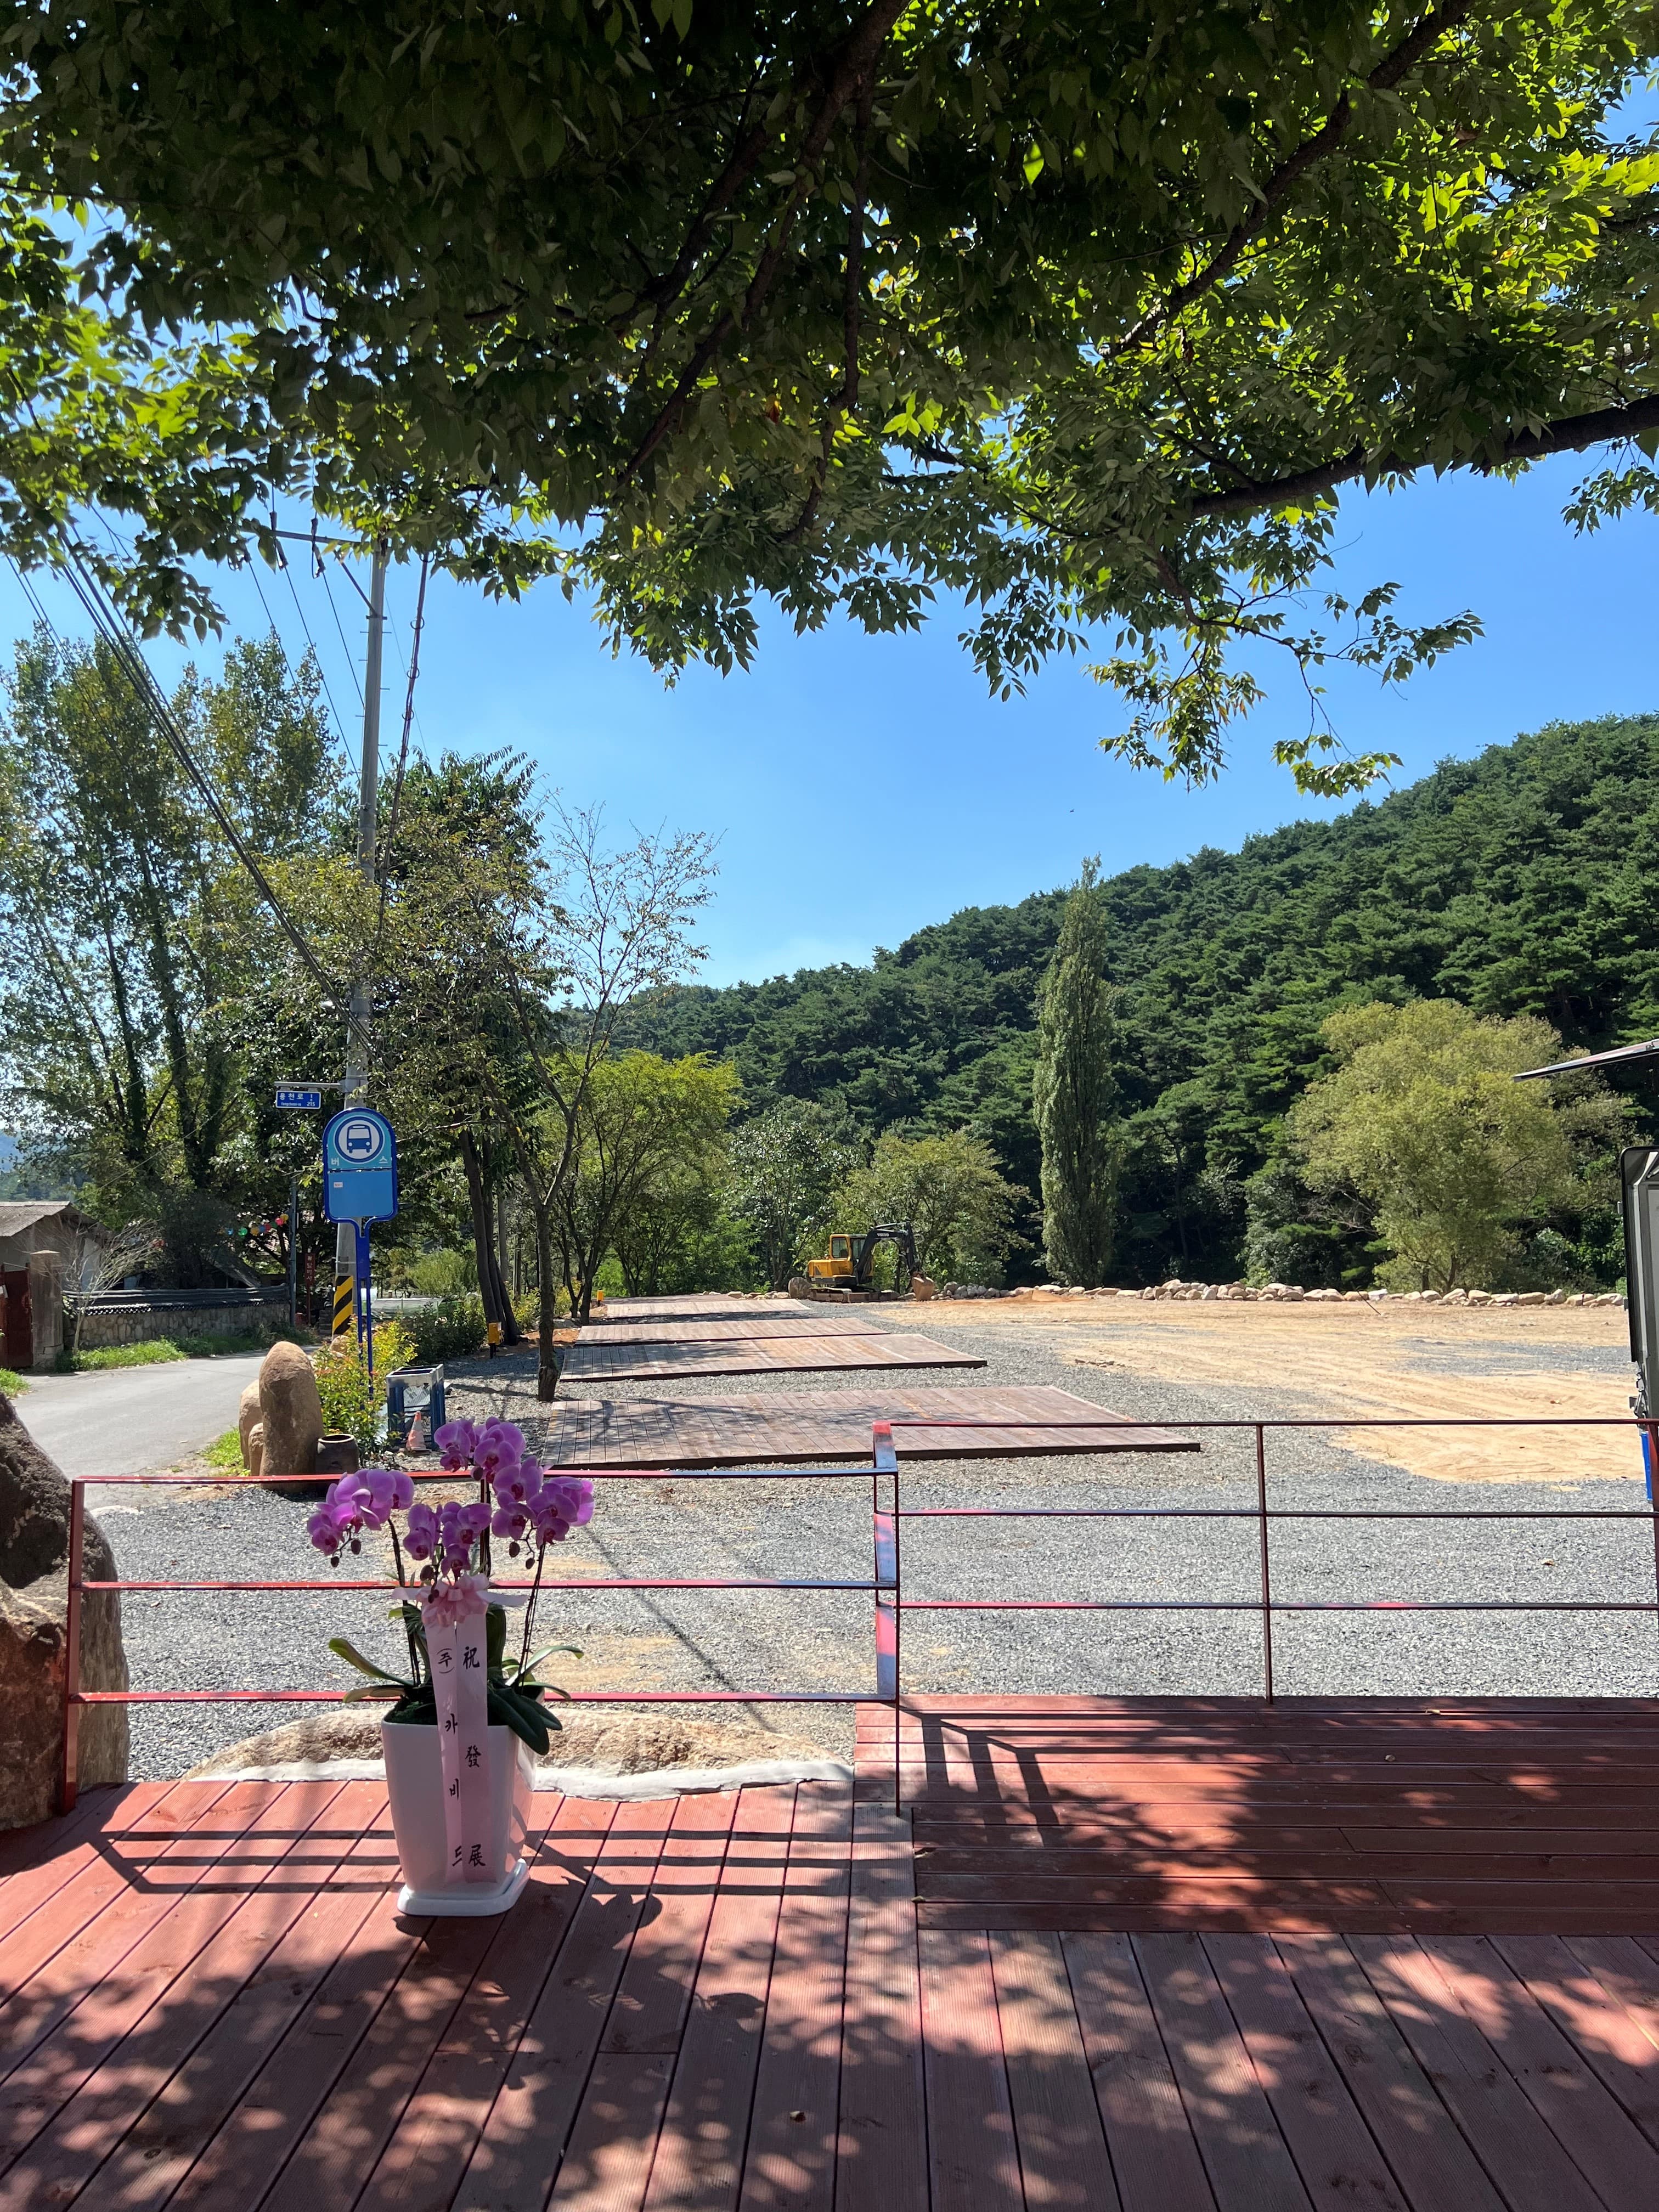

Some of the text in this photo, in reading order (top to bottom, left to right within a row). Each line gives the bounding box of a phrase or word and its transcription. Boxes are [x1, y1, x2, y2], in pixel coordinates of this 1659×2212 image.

[279, 1092, 304, 1101] 용천로
[331, 1155, 388, 1166] 버 스
